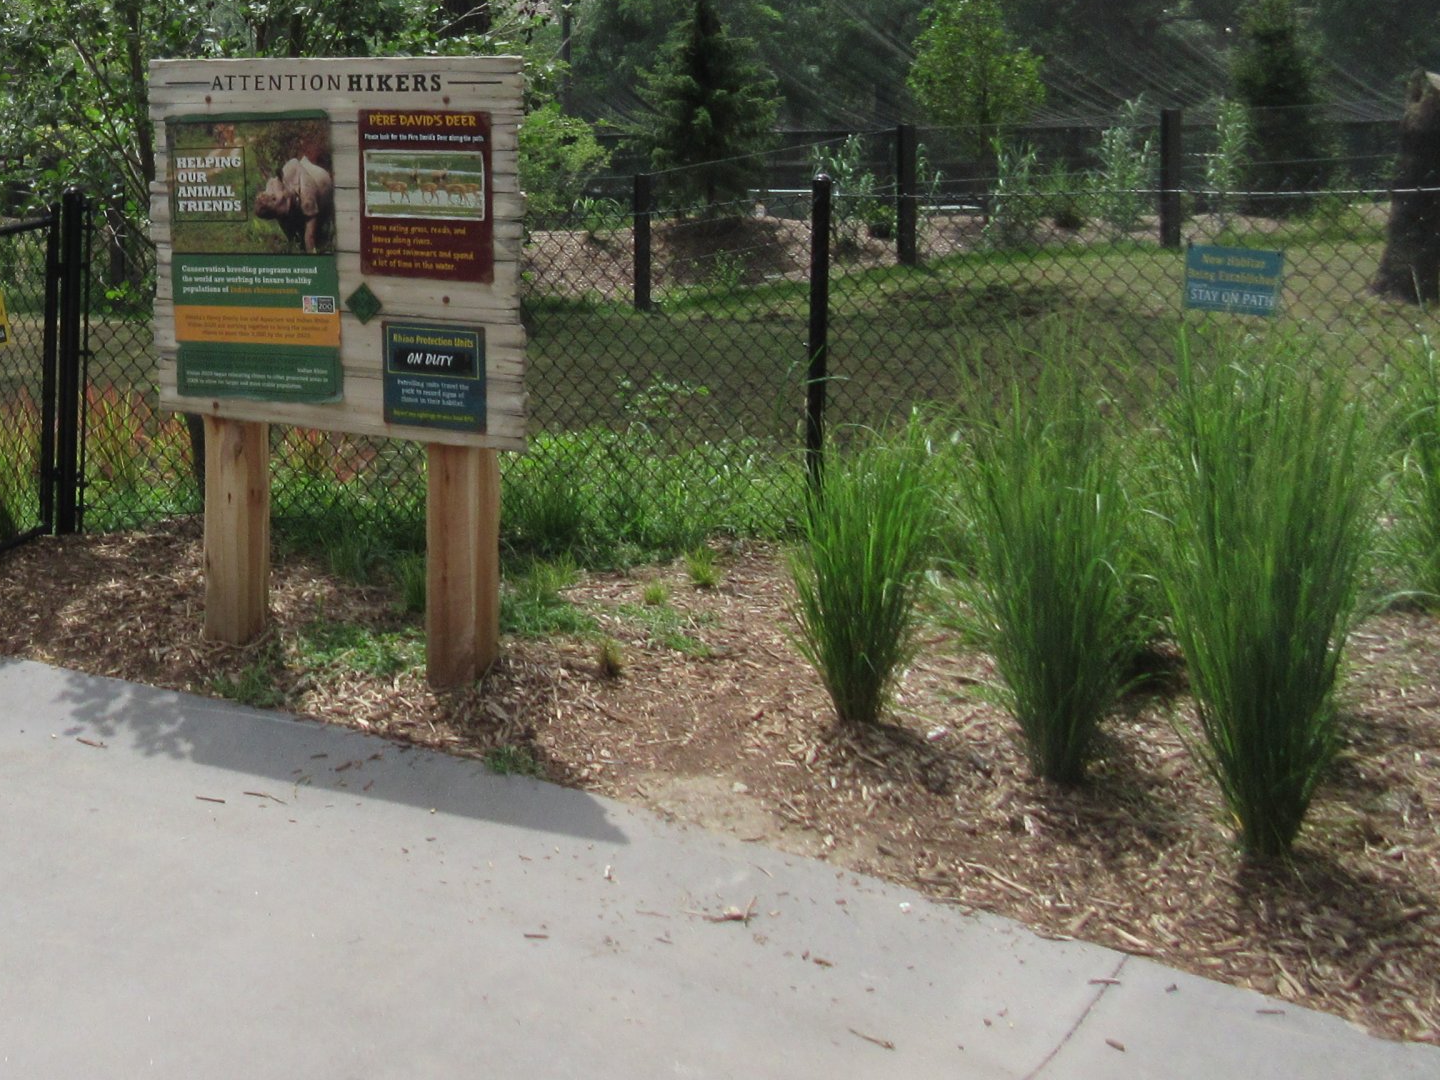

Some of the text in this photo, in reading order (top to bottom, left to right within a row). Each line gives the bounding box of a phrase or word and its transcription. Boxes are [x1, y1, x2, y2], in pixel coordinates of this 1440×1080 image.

[212, 74, 441, 92] ATTENTION HIKERS
[369, 112, 476, 127] PÈRE DAVID'S DEER
[449, 135, 463, 143] along
[176, 157, 241, 169] HELPING
[177, 171, 207, 183] OUR
[178, 185, 235, 197] ANIMAL
[178, 200, 242, 212] FRIENDS
[388, 225, 409, 234] eating
[453, 227, 466, 235] and
[392, 235, 411, 246] along
[385, 249, 400, 257] good
[403, 249, 437, 258] swimmers
[439, 250, 451, 258] and
[453, 251, 474, 261] spend
[182, 265, 225, 273] Conservation
[227, 265, 256, 274] breeding
[259, 267, 291, 275] programs
[379, 259, 388, 267] lot
[390, 259, 396, 267] of
[398, 260, 413, 268] time
[414, 261, 421, 269] in
[422, 261, 433, 270] the
[226, 276, 253, 285] working
[286, 277, 311, 285] healthy
[183, 285, 220, 294] populations
[222, 285, 229, 293] of
[1190, 288, 1274, 307] STAY ON PATH
[393, 333, 473, 348] Rhino Protection Units
[407, 352, 453, 366] ON DUTY
